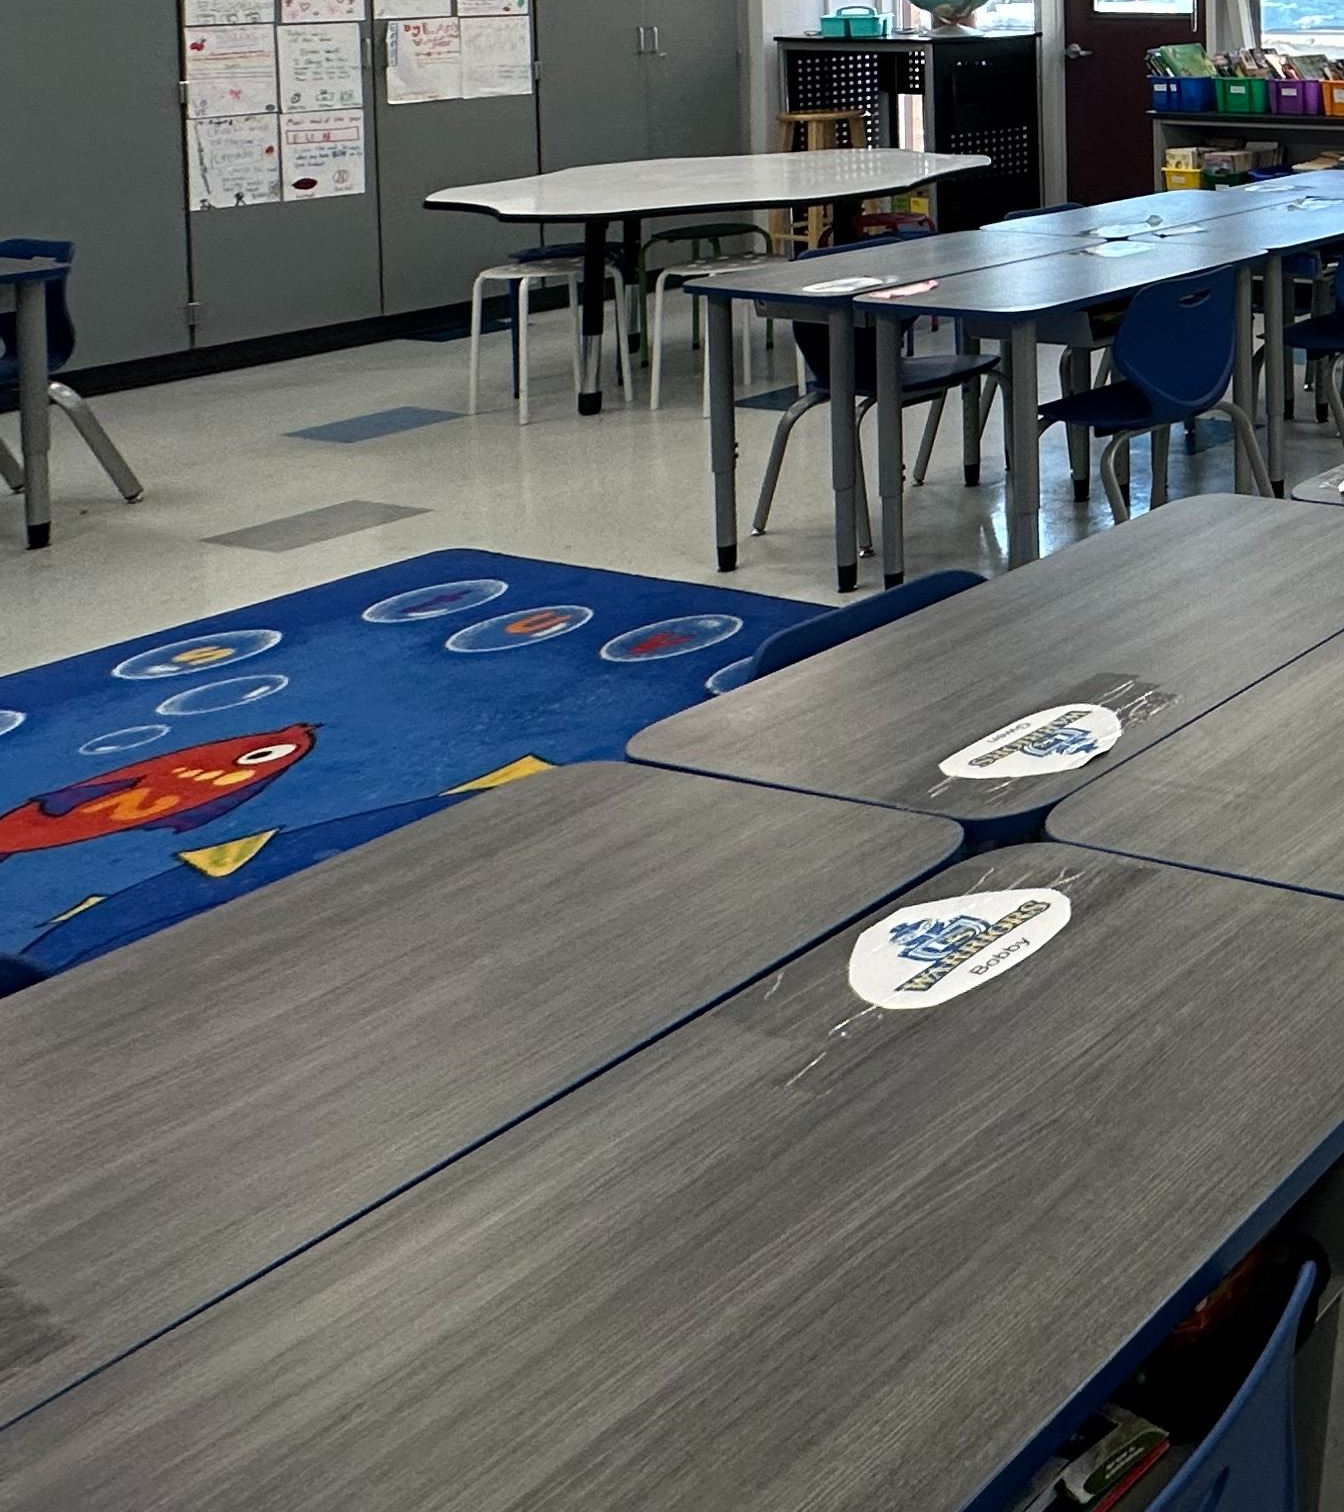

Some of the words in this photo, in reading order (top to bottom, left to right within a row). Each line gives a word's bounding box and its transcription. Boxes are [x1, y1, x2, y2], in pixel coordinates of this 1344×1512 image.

[969, 710, 1092, 768] WARRIORS
[900, 900, 1051, 991] WARRIORS
[970, 937, 1030, 977] Bobby
